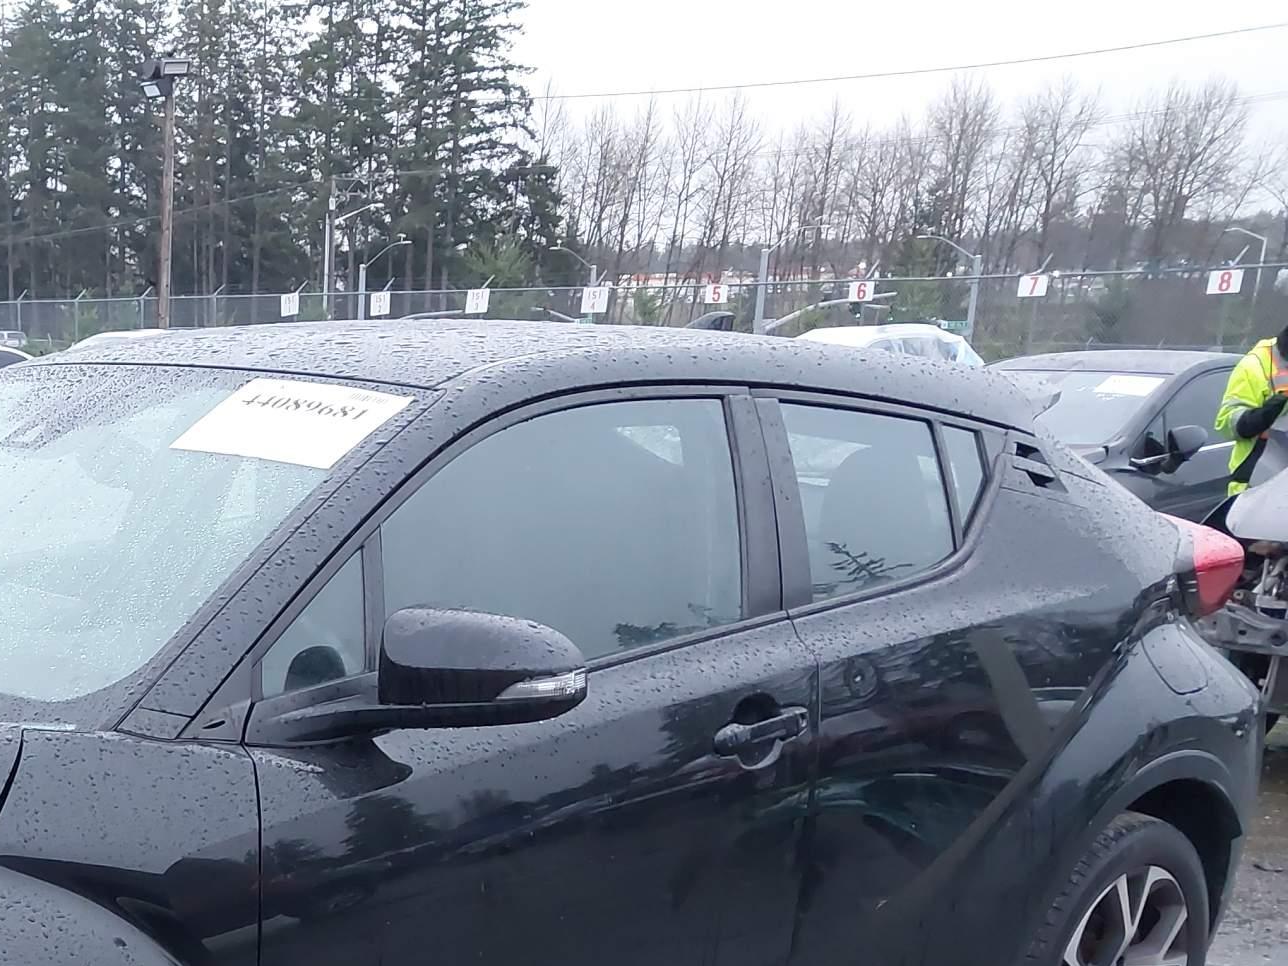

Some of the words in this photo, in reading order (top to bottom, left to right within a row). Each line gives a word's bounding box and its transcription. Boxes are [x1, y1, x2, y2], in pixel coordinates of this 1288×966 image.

[857, 282, 867, 300] 6
[1029, 276, 1040, 296] 7
[1218, 271, 1232, 292] 8
[712, 286, 721, 302] 5
[241, 394, 369, 420] 44089681
